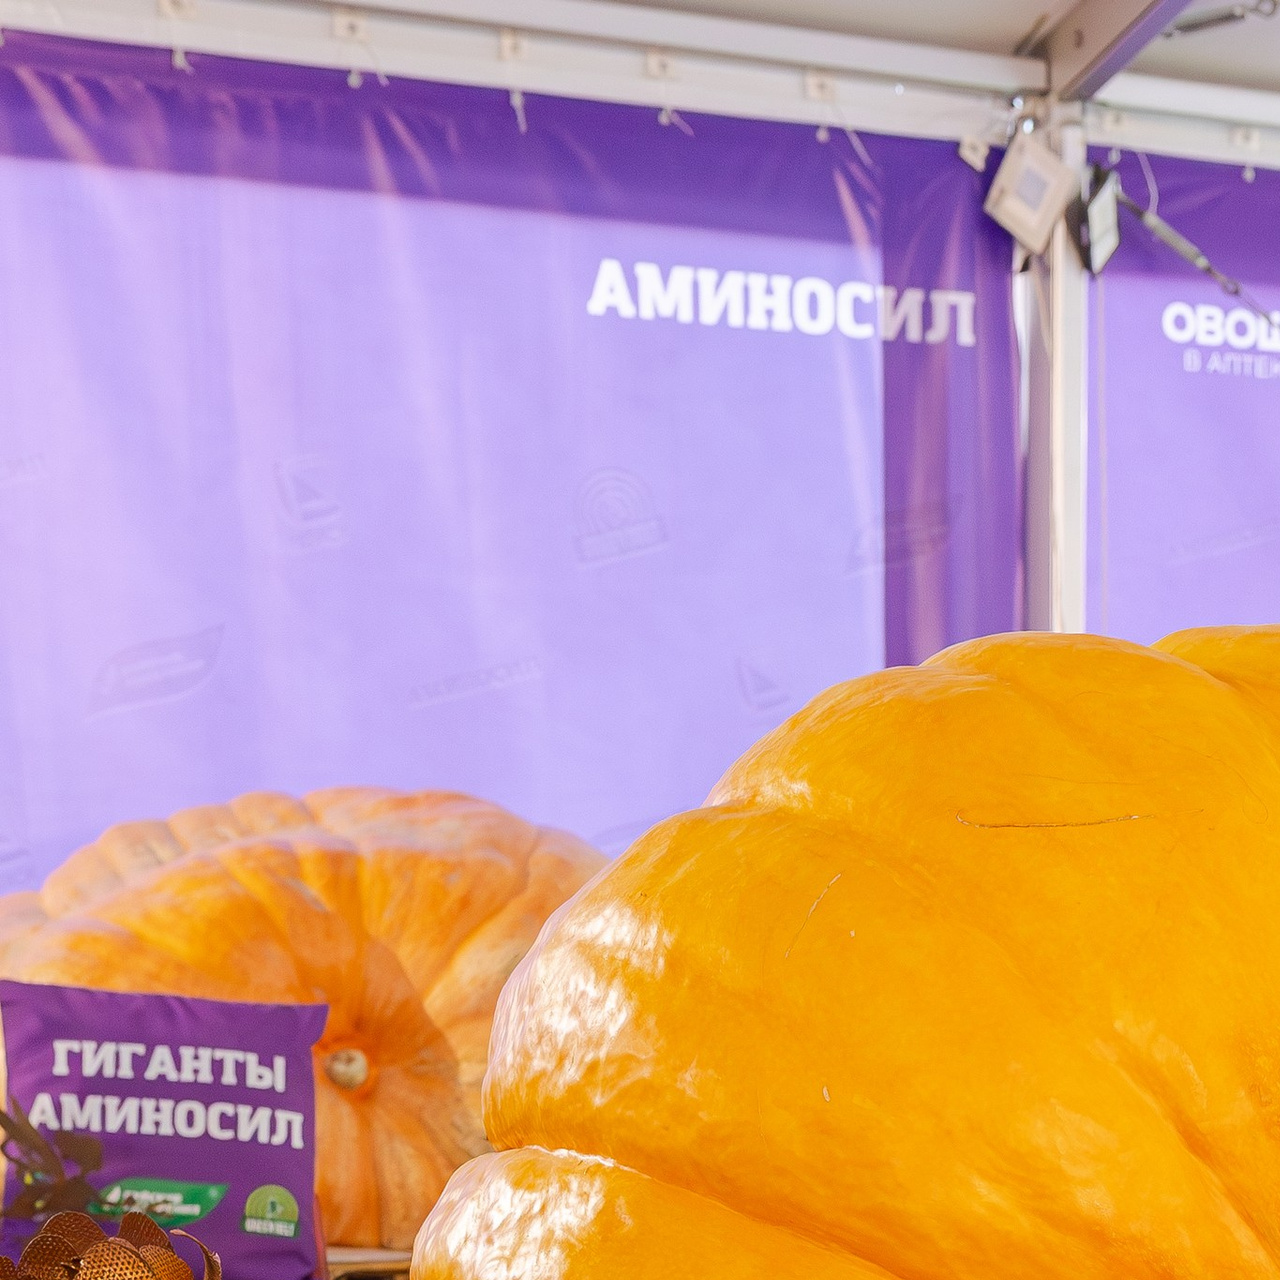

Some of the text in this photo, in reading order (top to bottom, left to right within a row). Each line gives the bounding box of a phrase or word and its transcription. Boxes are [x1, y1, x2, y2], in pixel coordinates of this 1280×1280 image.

[586, 257, 977, 348] АМИНОСИЛ
[1183, 349, 1200, 372] В
[52, 1038, 287, 1094] ГИГАНТЫ
[28, 1092, 304, 1150] АМИНОСИЛ
